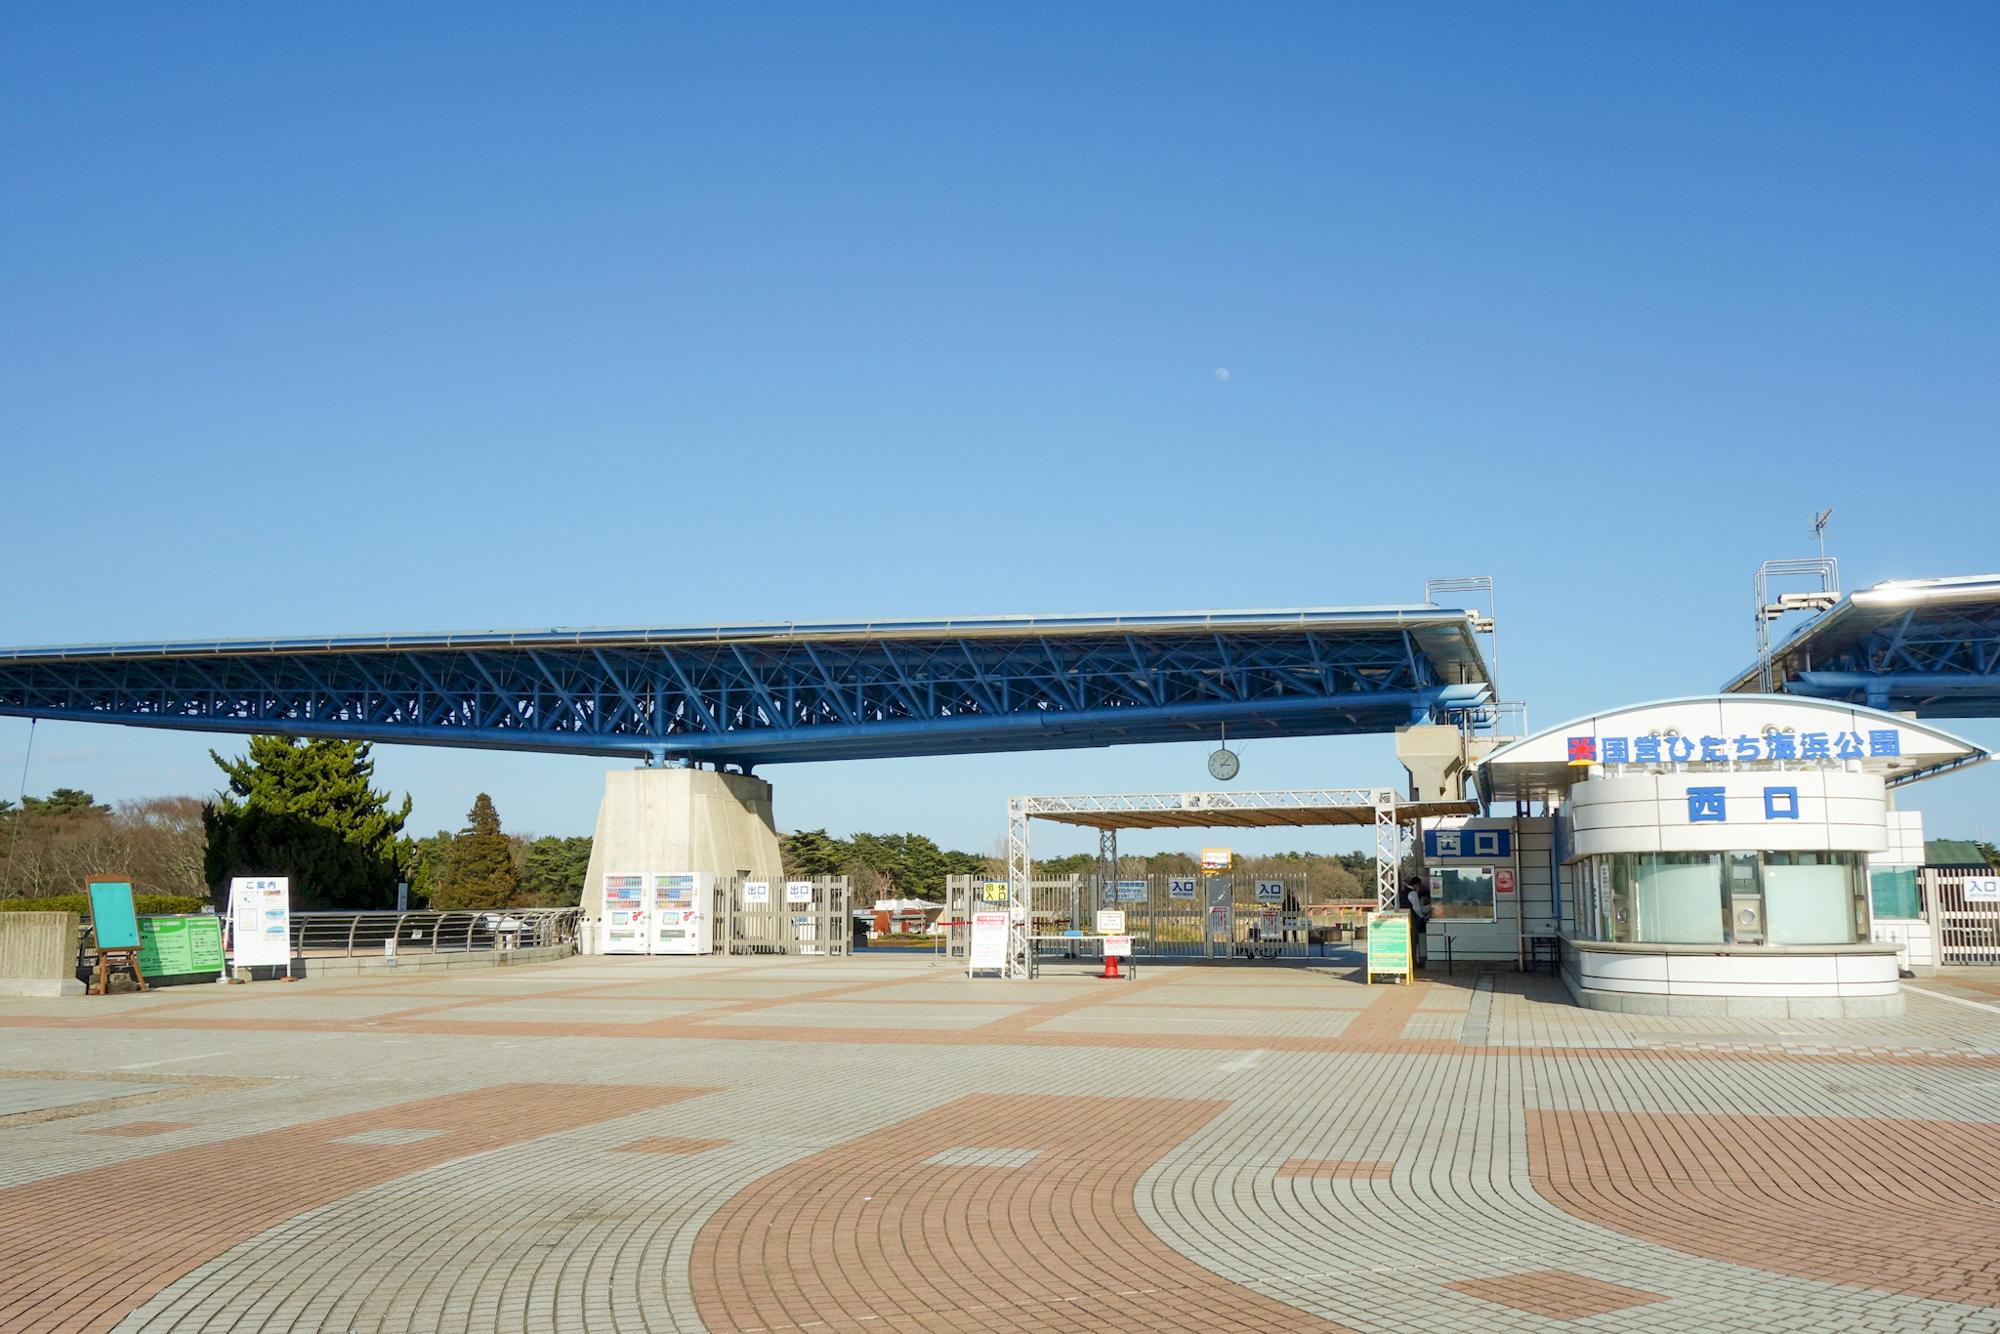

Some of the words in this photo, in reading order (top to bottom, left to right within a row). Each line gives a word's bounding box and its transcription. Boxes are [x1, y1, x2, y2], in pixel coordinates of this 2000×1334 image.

[1601, 729, 1900, 764] 国営ひたち海浜公園
[1686, 785, 1800, 822] 西口
[1435, 831, 1499, 856] 西口
[245, 880, 277, 890] ご案内
[747, 885, 766, 895] 出口
[790, 884, 809, 895] 出口
[985, 883, 1006, 892] 団体
[1172, 881, 1194, 892] 入口
[1259, 883, 1281, 895] 入口
[1969, 880, 1997, 892] 入口
[986, 892, 1006, 901] 入口
